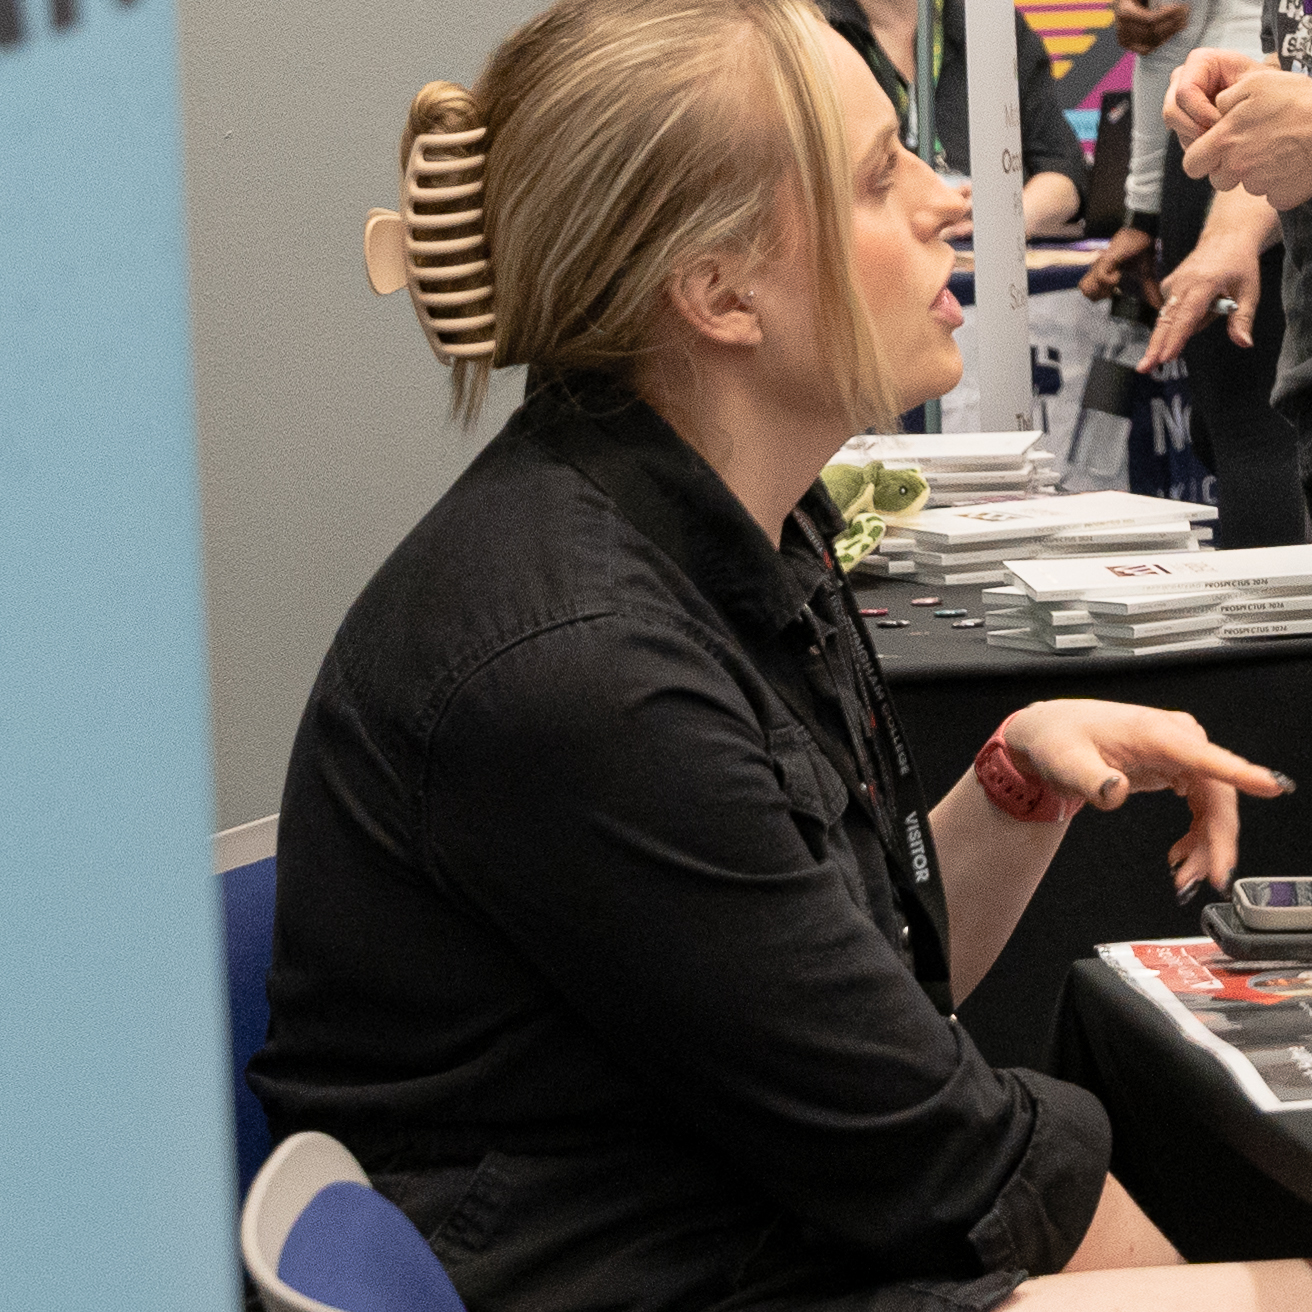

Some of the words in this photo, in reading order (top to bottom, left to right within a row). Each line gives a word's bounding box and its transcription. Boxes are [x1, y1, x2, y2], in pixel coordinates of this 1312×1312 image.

[1204, 579, 1252, 589] PROSPECTUS
[1252, 577, 1269, 586] 2026
[1220, 603, 1267, 613] PROSPECTUS
[1223, 626, 1270, 636] PROSPECTUS
[903, 809, 931, 884] VISITOR
